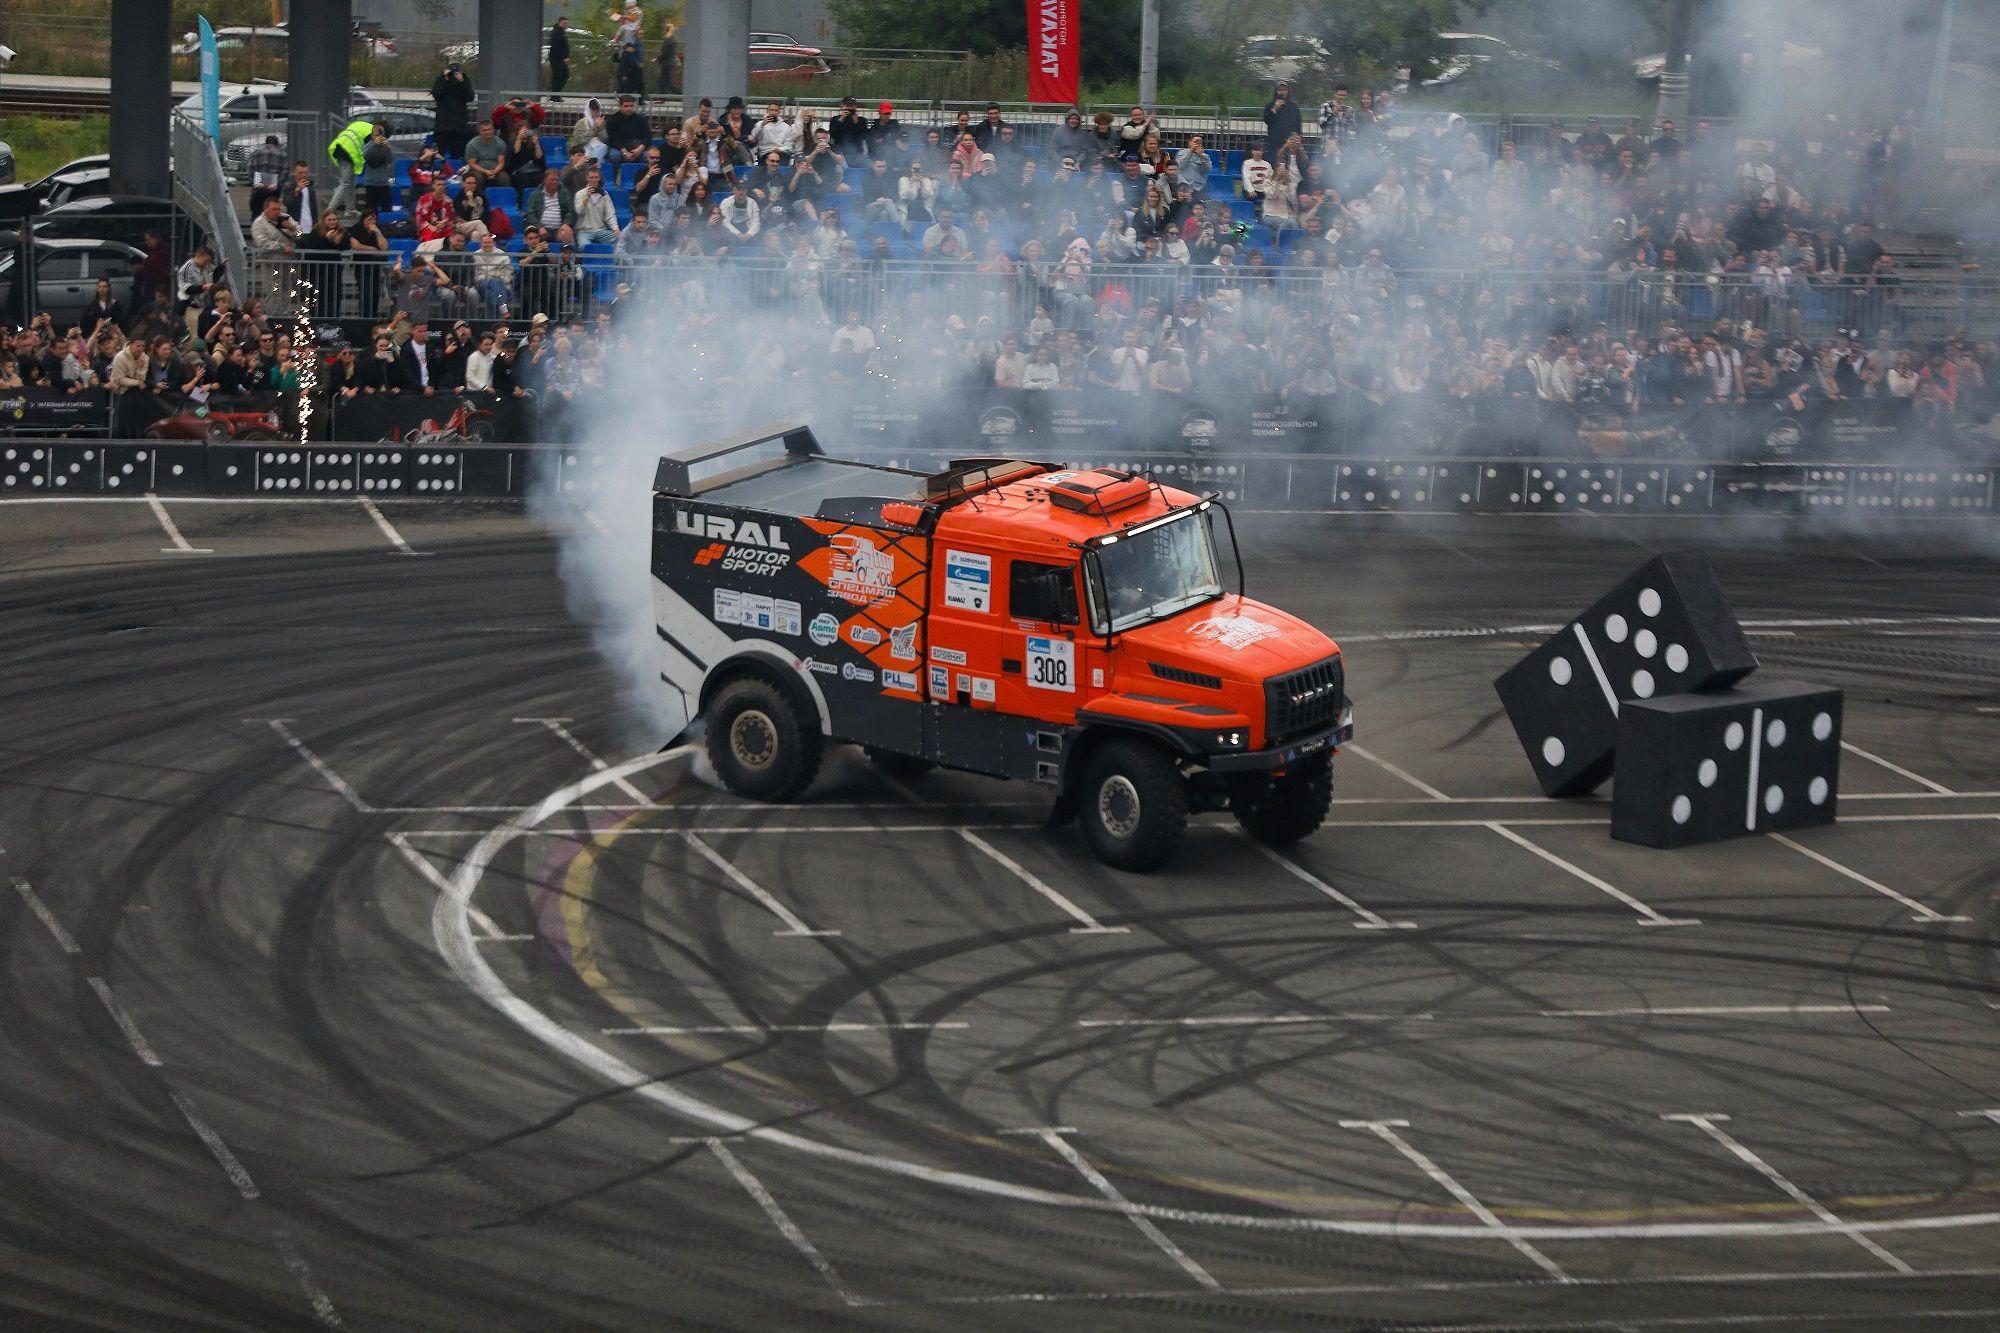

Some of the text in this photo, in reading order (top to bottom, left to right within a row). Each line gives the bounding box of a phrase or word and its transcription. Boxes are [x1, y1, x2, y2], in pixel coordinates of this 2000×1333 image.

[676, 510, 790, 551] URAL
[727, 545, 791, 567] MOTOR
[721, 560, 782, 577] SPORT
[827, 590, 868, 604] ЗАВОД
[828, 580, 896, 598] СПЕЦМАШ
[1034, 655, 1069, 687] 308
